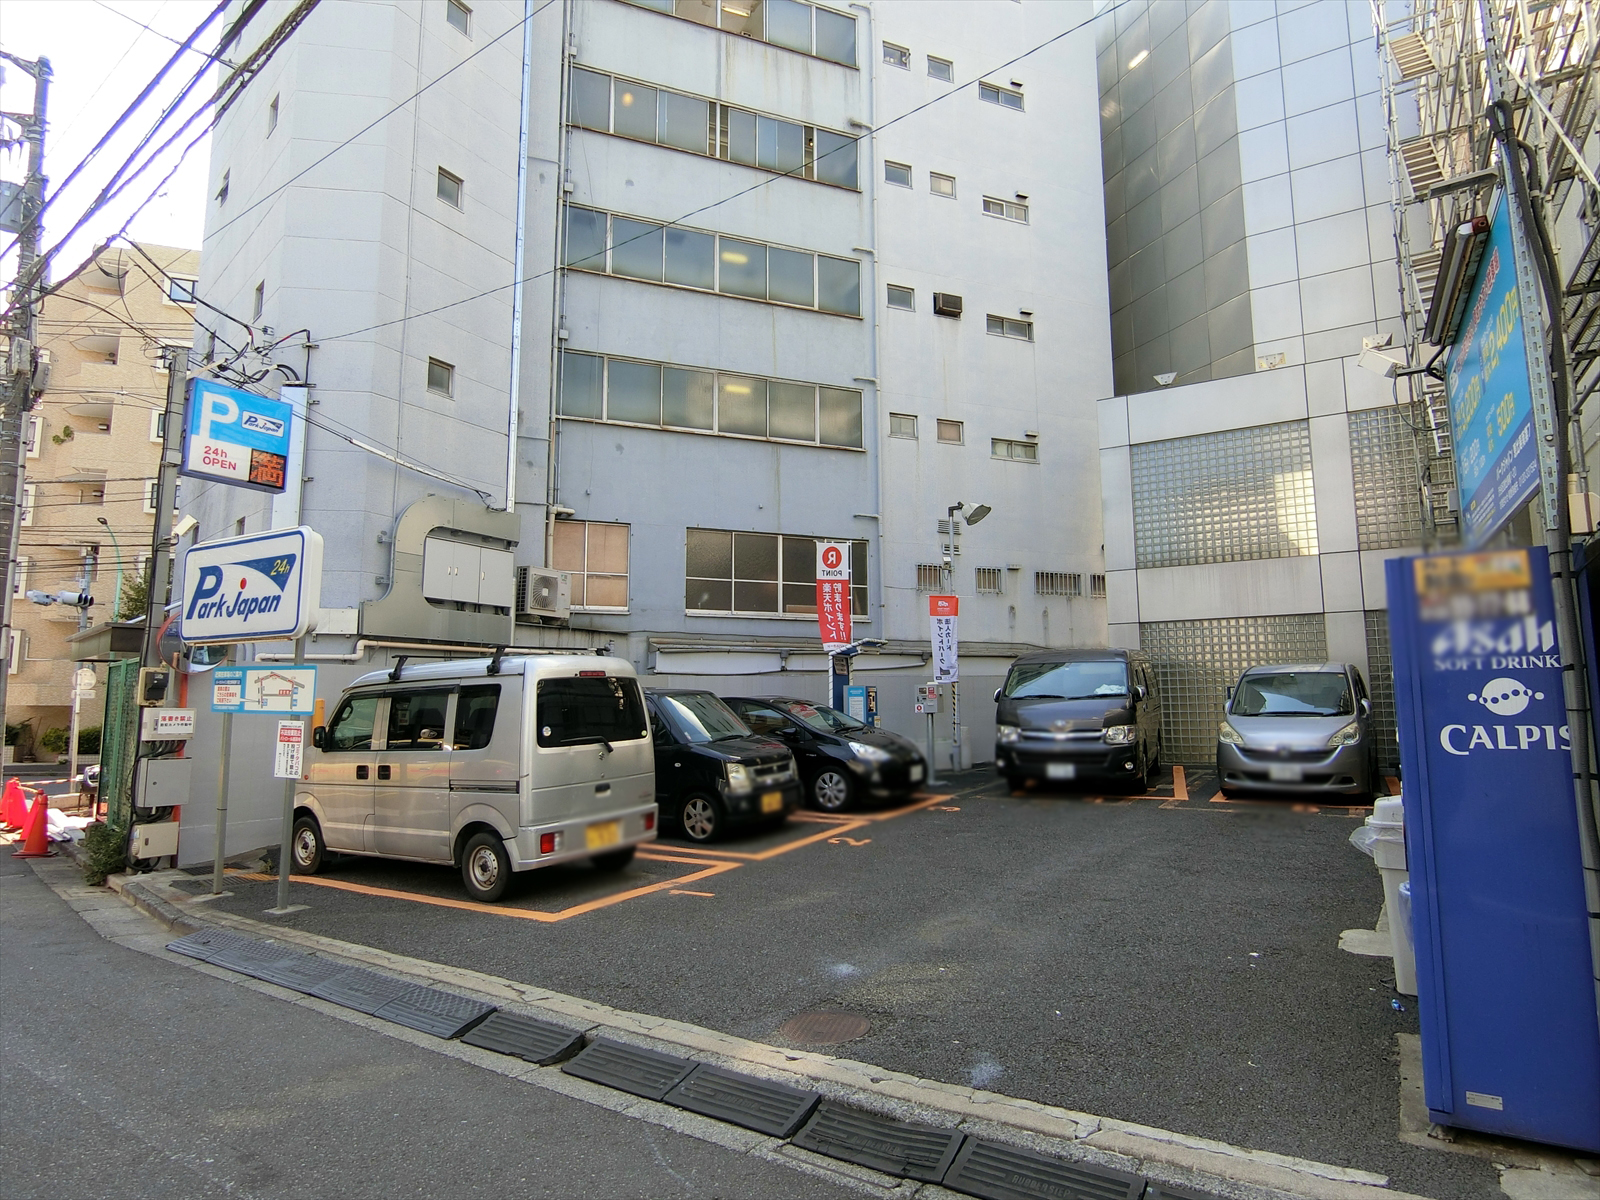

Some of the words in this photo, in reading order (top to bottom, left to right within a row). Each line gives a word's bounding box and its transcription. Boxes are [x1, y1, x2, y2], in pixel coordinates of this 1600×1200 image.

[199, 391, 240, 439] P
[204, 445, 228, 458] 24h
[202, 456, 237, 470] OPEN
[270, 559, 290, 576] 24h
[185, 565, 228, 620] Park
[226, 590, 282, 622] Japan
[1432, 615, 1554, 655] Asah
[1434, 657, 1485, 671] SOFT
